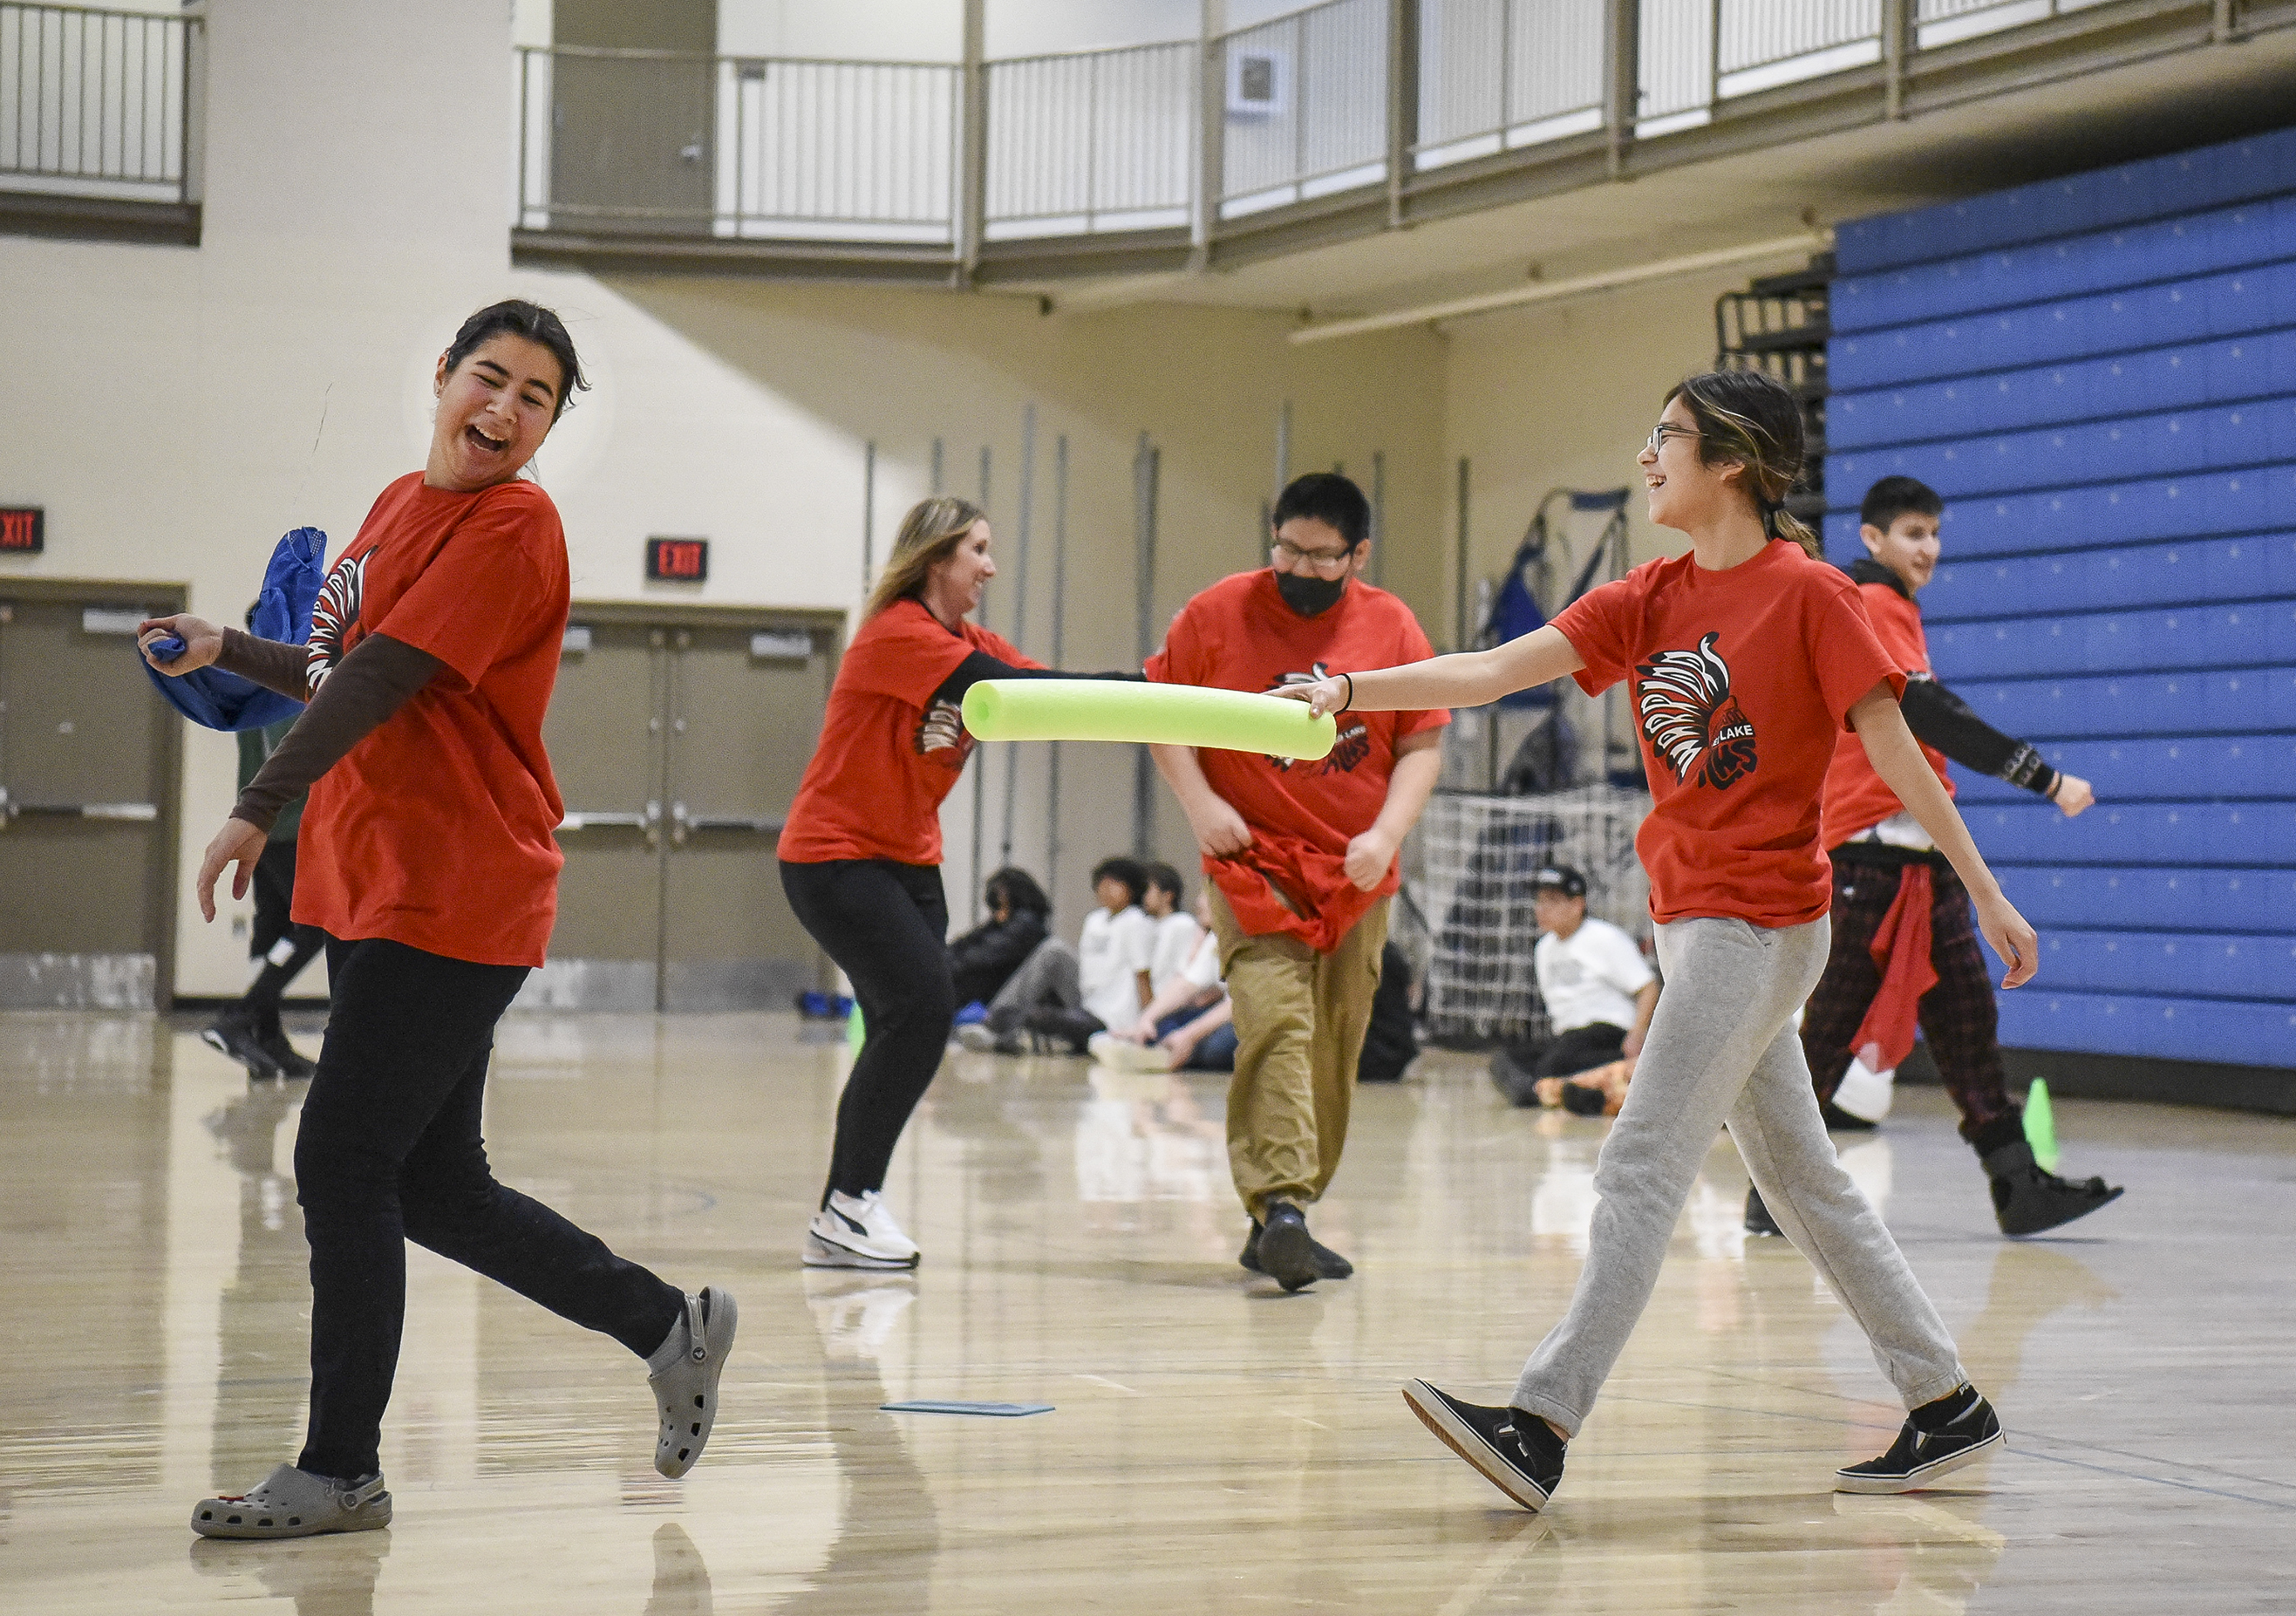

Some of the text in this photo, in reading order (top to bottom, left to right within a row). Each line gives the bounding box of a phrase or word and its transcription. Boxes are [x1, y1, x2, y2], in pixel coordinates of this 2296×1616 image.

[0, 513, 34, 546] XIT
[658, 542, 701, 575] EXIT
[1720, 725, 1754, 740] LAKE
